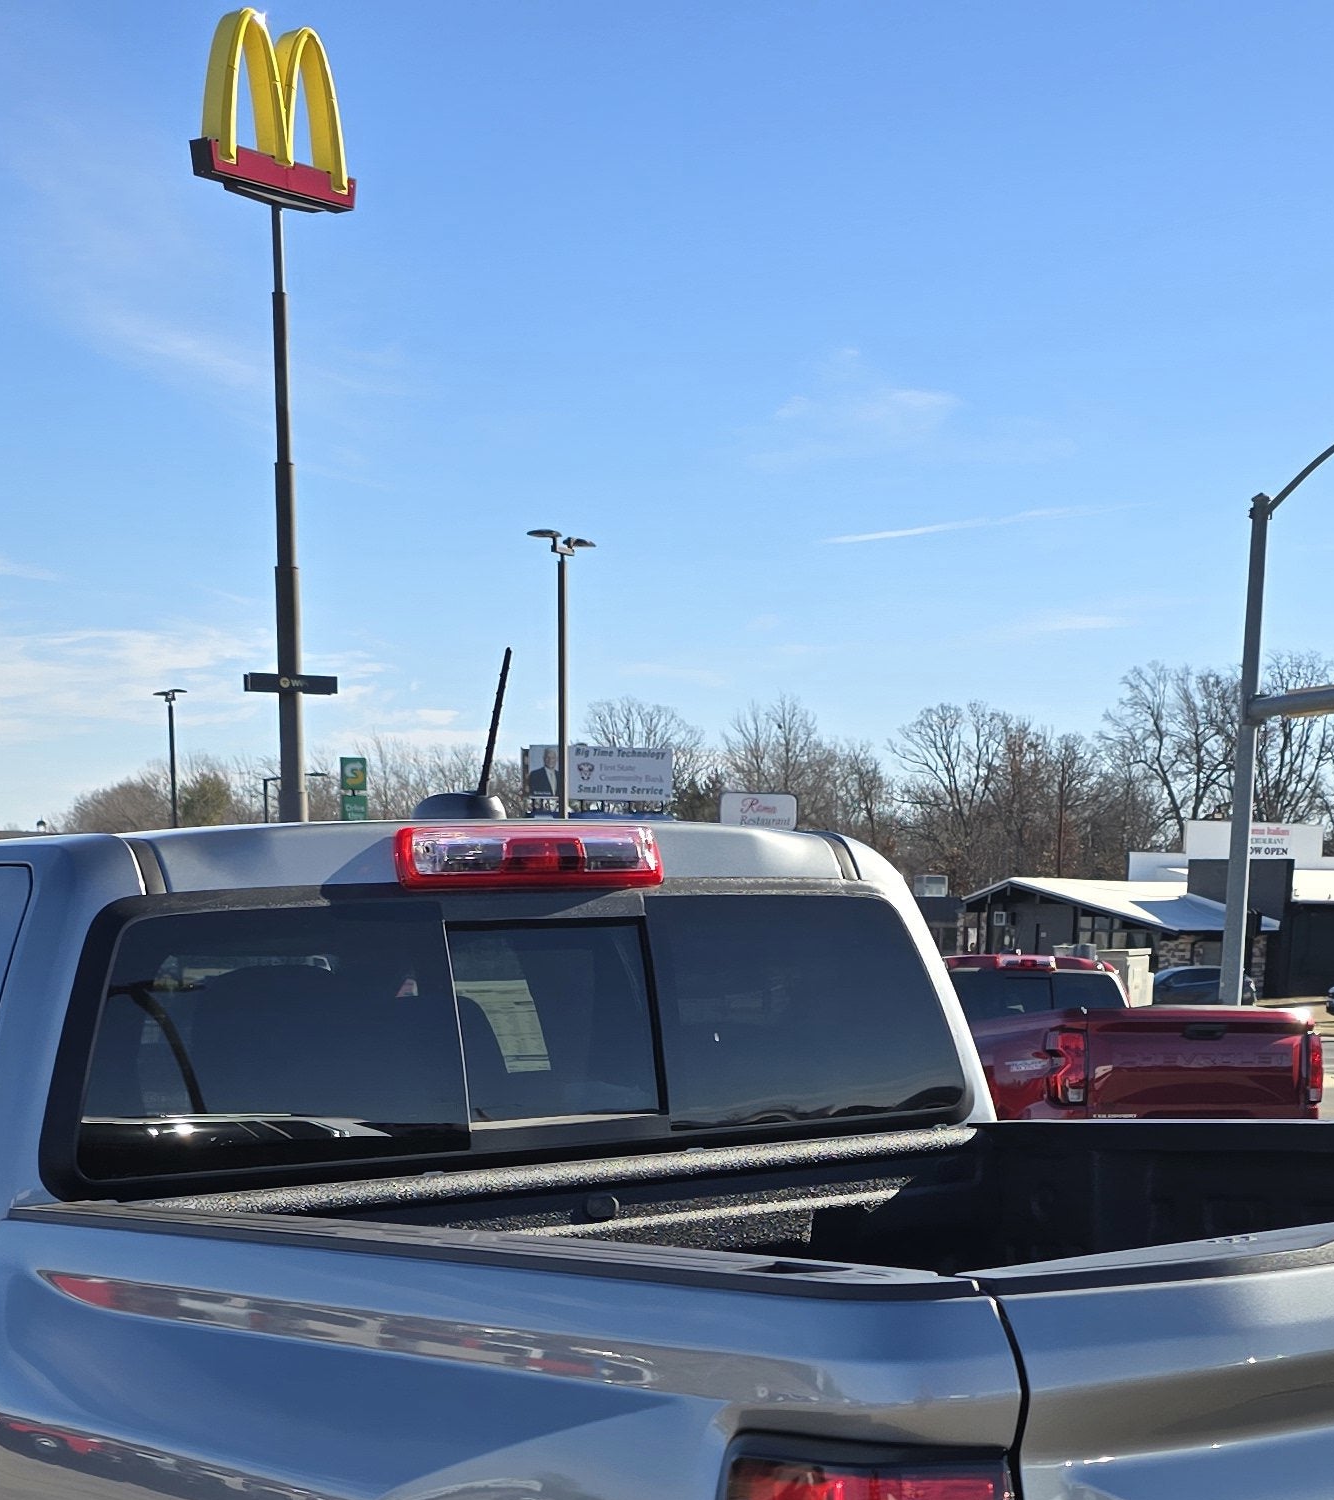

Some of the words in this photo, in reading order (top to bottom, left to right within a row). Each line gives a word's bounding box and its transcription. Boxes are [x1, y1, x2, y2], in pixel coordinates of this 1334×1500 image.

[574, 747, 590, 758] Big
[593, 748, 614, 757] Time
[616, 749, 666, 760] Technology
[577, 784, 603, 794] Small
[605, 785, 628, 794] Town
[630, 785, 664, 795] Service
[740, 815, 790, 826] Restaurant
[1264, 847, 1288, 856] OPEN
